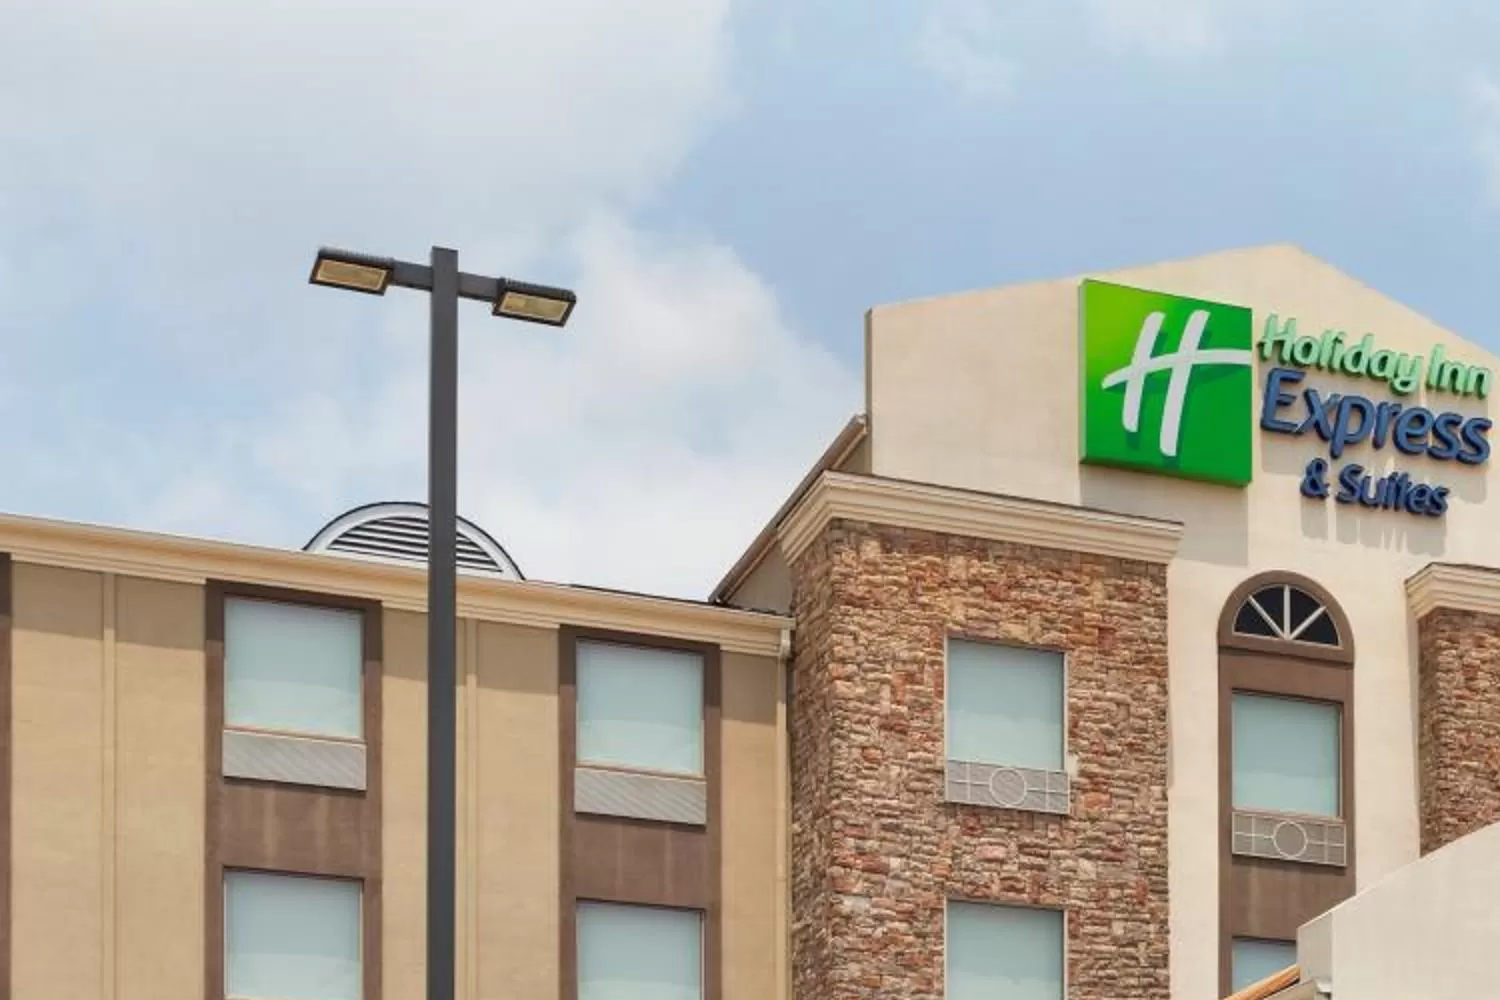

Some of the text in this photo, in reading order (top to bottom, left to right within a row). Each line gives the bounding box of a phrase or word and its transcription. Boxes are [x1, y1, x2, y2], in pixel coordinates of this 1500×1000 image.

[1102, 310, 1251, 456] H
[1257, 313, 1492, 399] Holiday Inn
[1260, 368, 1493, 465] Express
[1300, 458, 1449, 517] & Suites
